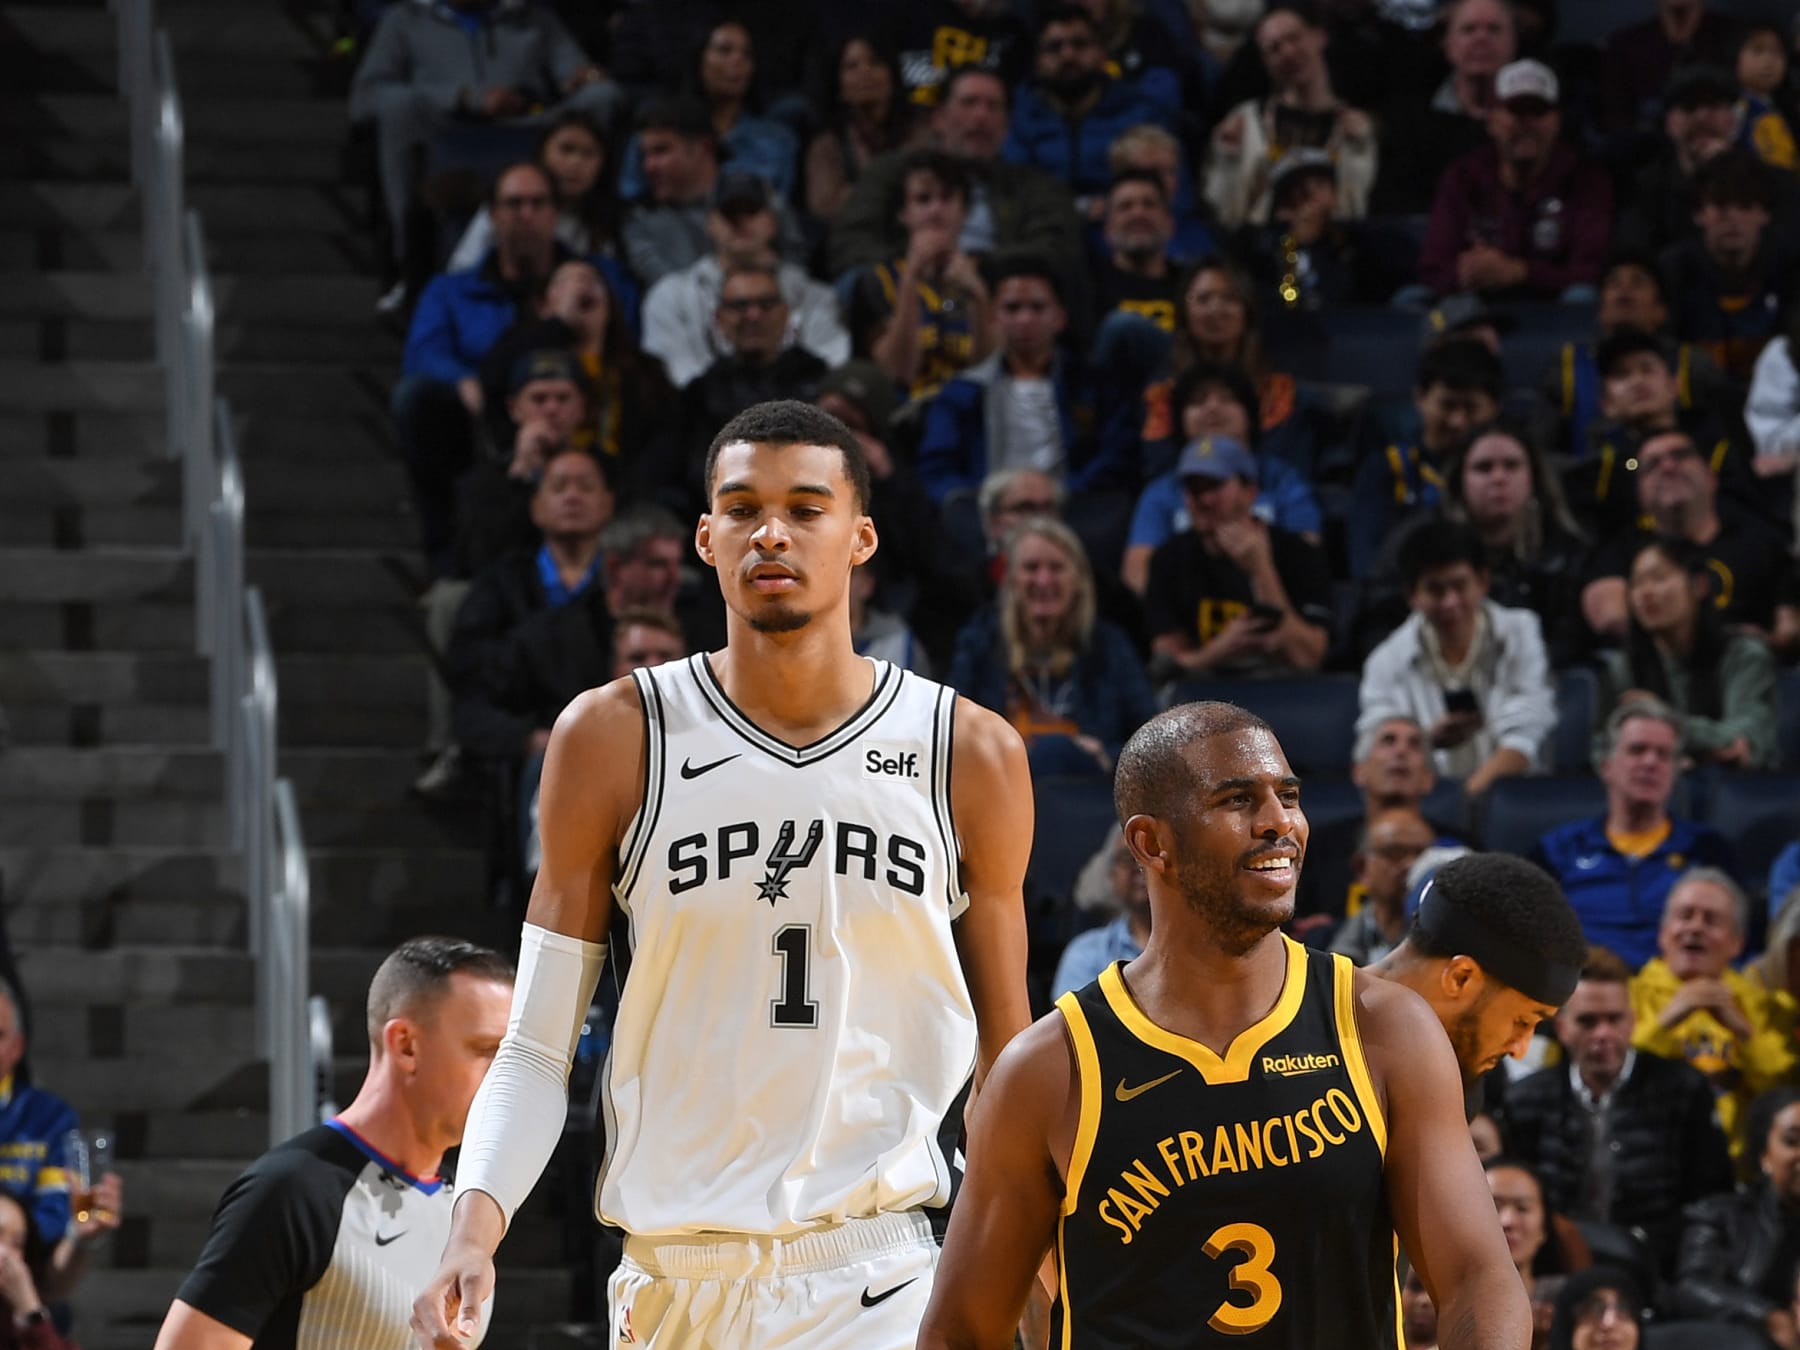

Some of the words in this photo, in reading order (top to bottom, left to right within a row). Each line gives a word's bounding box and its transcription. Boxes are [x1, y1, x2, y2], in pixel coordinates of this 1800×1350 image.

[865, 750, 920, 778] Self.
[668, 819, 926, 907] SPURS
[770, 923, 820, 1029] 1
[1262, 1053, 1340, 1074] Rakuten
[1098, 1158, 1171, 1245] SAN
[1156, 1088, 1362, 1188] FRANCISCO
[1200, 1222, 1283, 1336] 3
